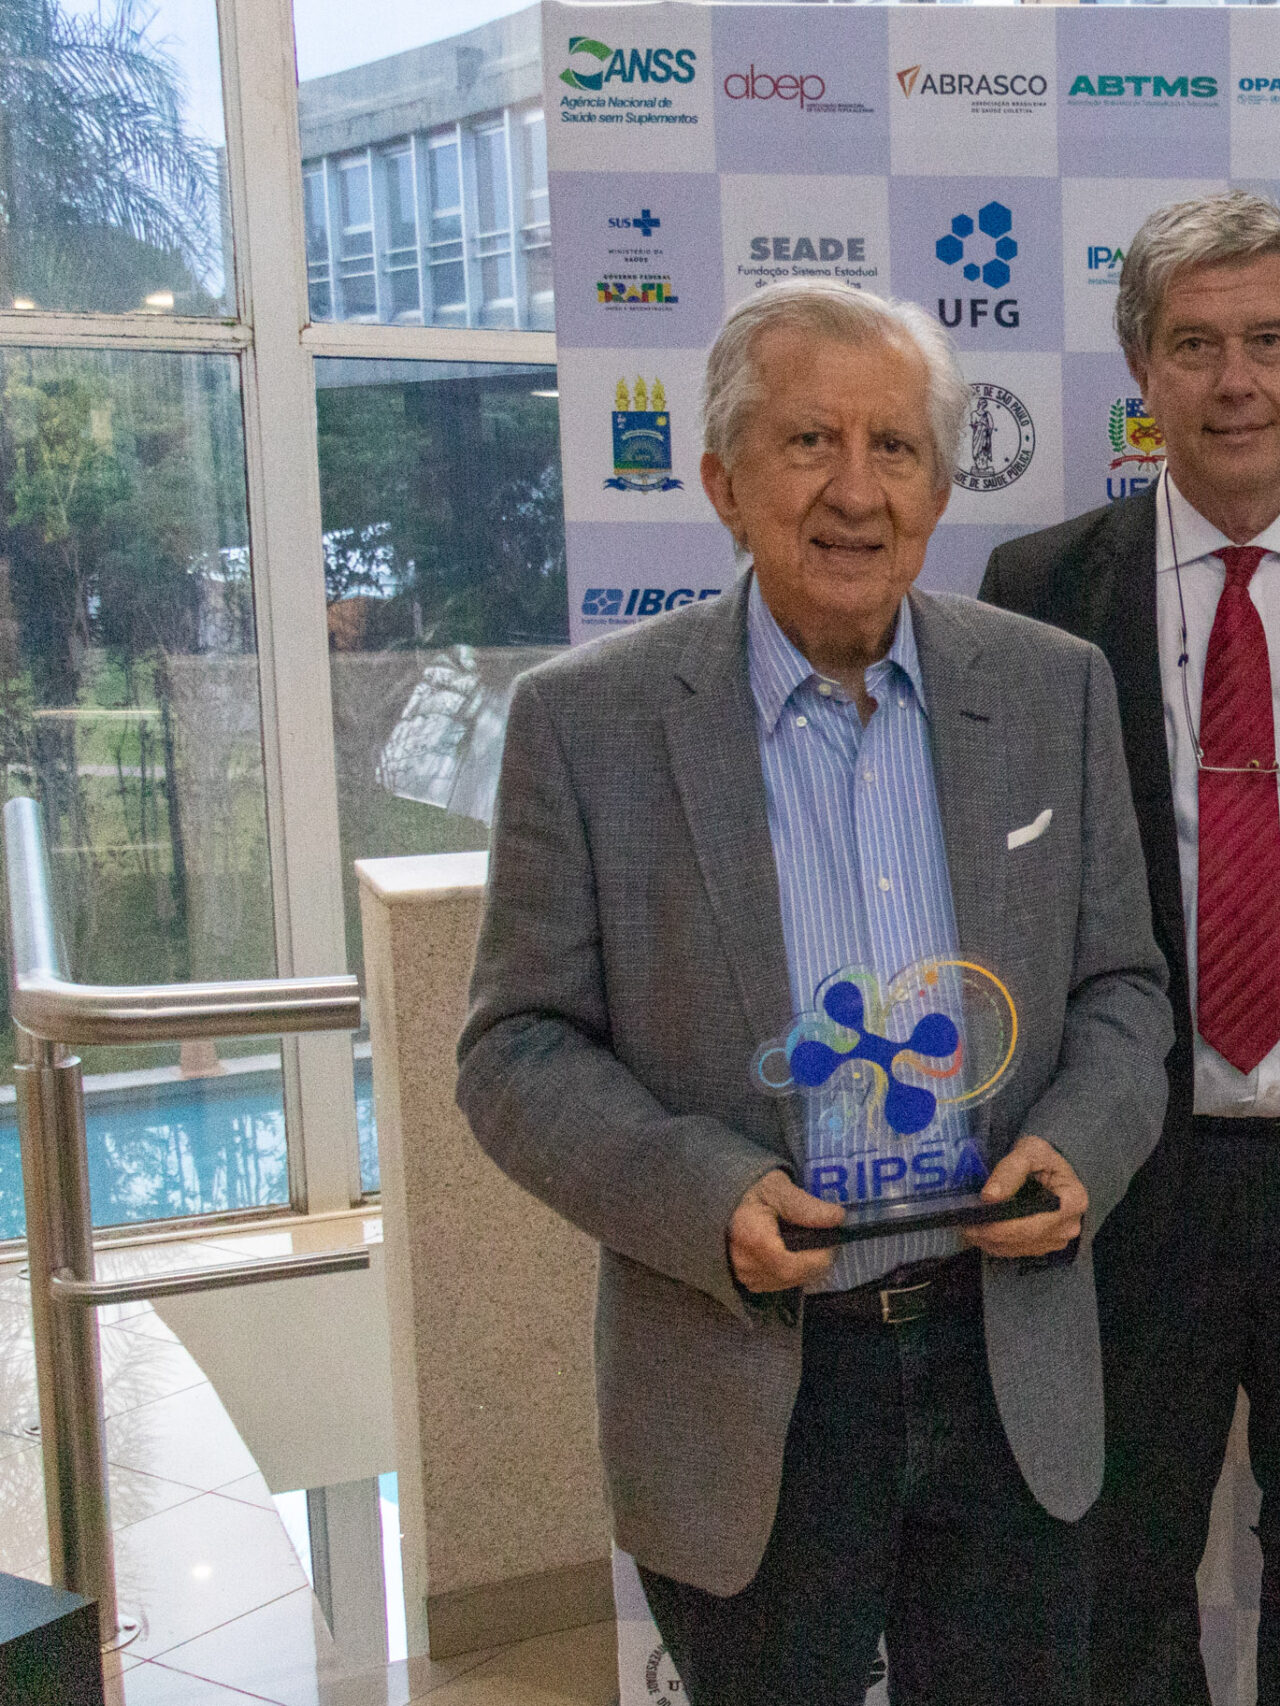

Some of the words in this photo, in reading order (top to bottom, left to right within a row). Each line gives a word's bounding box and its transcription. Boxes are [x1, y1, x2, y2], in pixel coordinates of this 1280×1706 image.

[604, 48, 696, 83] ANSS
[724, 64, 825, 109] abep
[921, 74, 1047, 96] ABRASCO
[1068, 75, 1218, 98] ABTMS
[608, 97, 656, 108] Nacional
[658, 98, 672, 108] de
[561, 111, 597, 123] Saúde
[598, 114, 624, 122] sem
[625, 112, 698, 125] Suplementos
[608, 217, 631, 228] SUS
[750, 236, 865, 262] SEADE
[738, 265, 789, 279] Fundação
[792, 266, 830, 277] Sistema
[835, 266, 878, 277] Estadual
[938, 299, 1020, 328] UFG
[1010, 401, 1031, 427] PAULO
[811, 1138, 989, 1203] RIPSA
